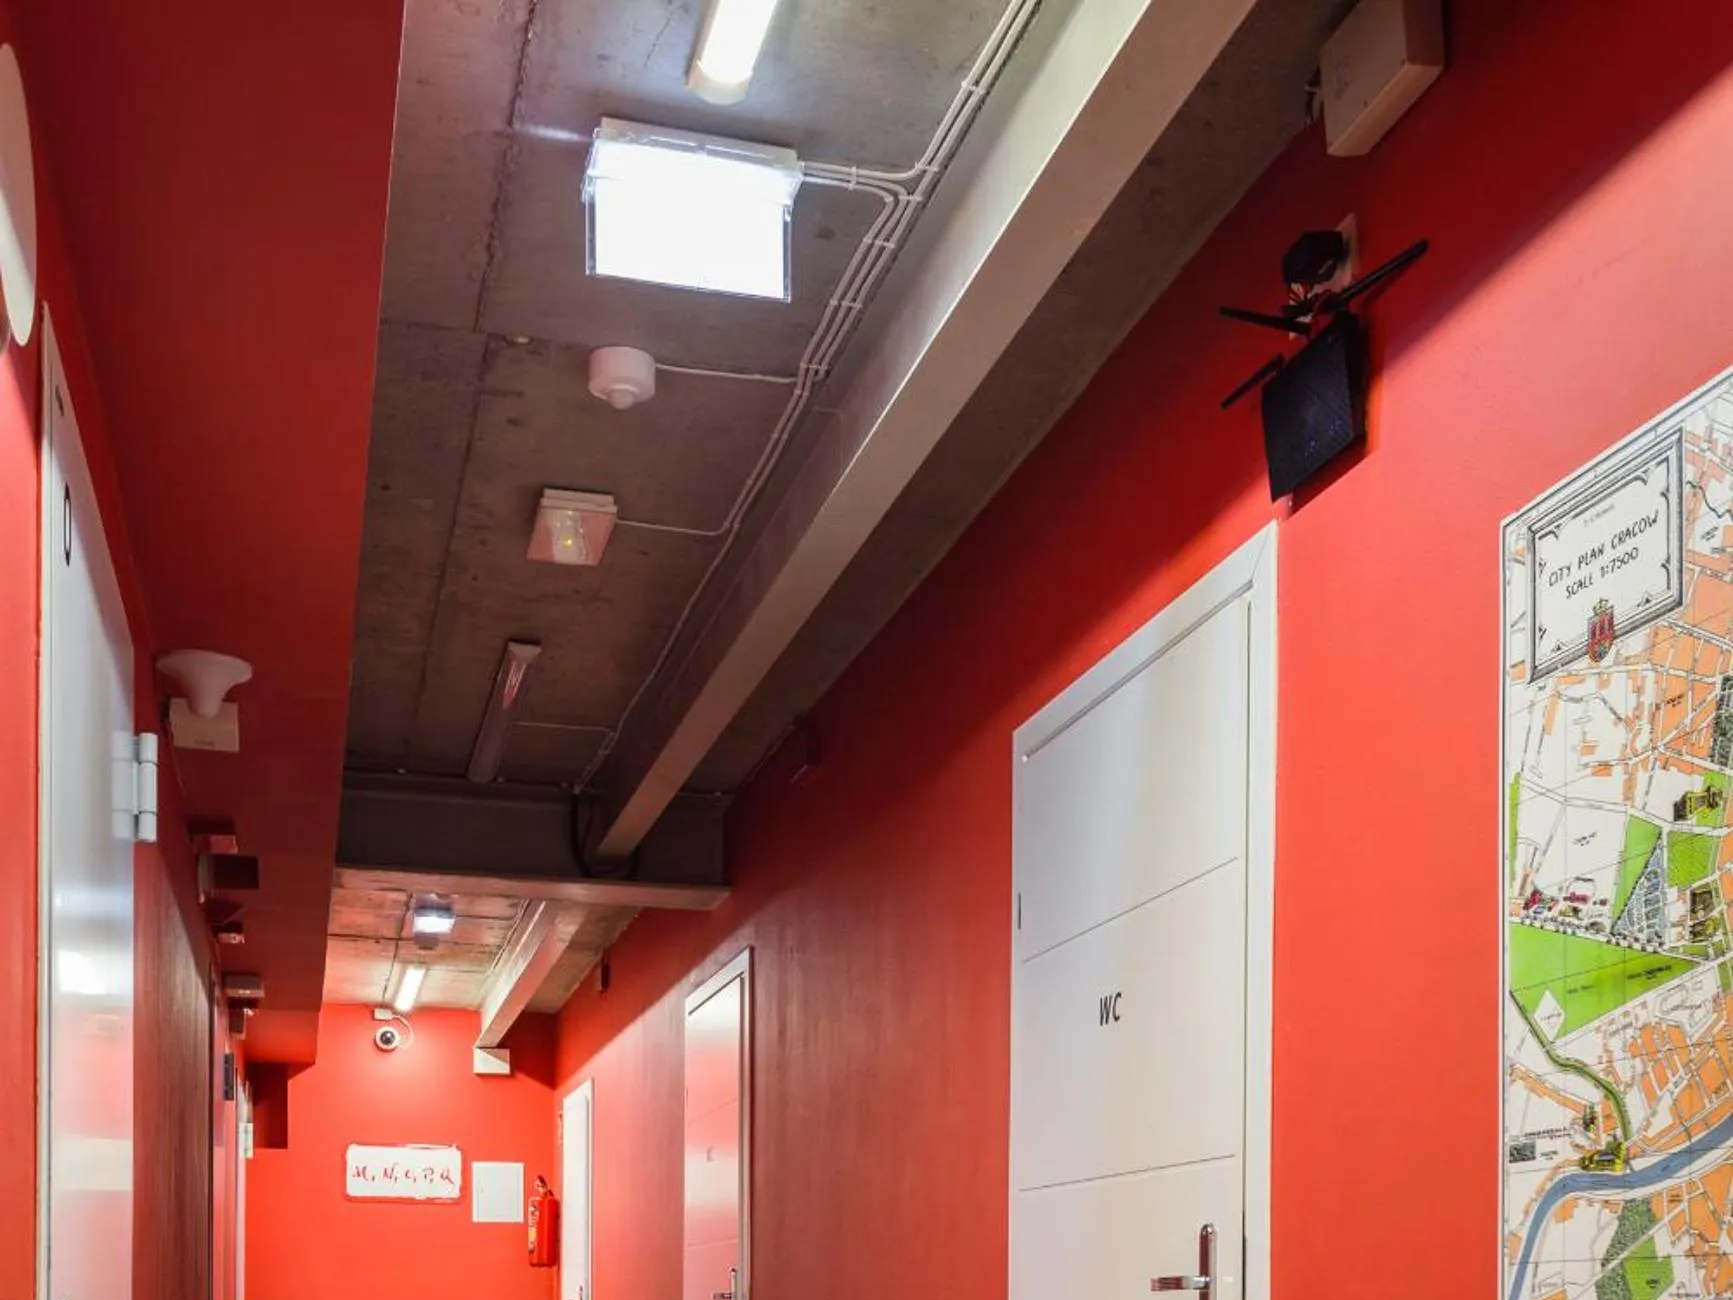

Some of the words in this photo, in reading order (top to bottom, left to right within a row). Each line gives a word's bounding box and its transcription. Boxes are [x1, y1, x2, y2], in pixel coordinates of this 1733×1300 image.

[1549, 563, 1571, 588] CITY
[1578, 543, 1605, 571] PLAN
[1611, 509, 1659, 550] CRACOW
[1100, 991, 1122, 1027] WC
